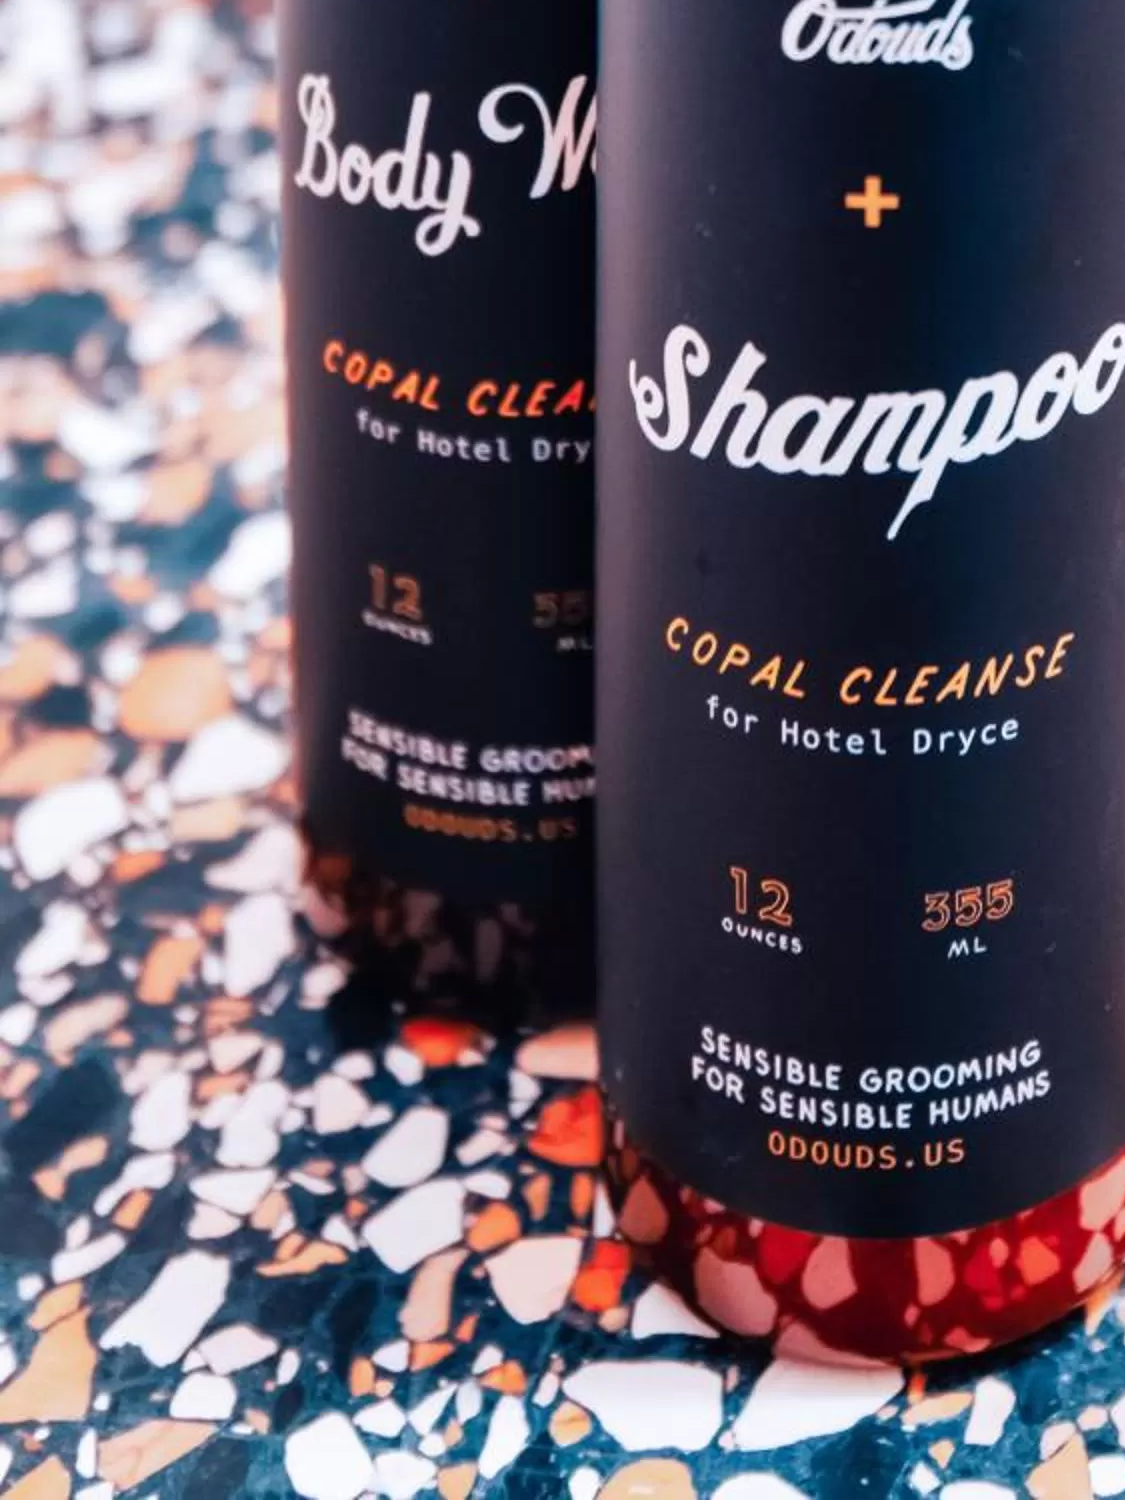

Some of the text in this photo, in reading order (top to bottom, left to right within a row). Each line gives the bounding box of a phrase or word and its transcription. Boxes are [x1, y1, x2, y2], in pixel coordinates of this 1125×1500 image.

[295, 74, 597, 257] Body W
[322, 340, 595, 418] COPAL CLEA
[357, 408, 401, 444] for
[417, 431, 511, 462] Hotel
[368, 563, 424, 622] 12
[665, 617, 1075, 706] COPAL CLEANSE
[348, 708, 468, 771] SENSIBLE
[706, 695, 1020, 756] for Hotel Dryce
[340, 736, 388, 782] FOR
[396, 761, 531, 807] SENSIBLE
[729, 866, 793, 928] 12
[922, 878, 1014, 931] 355
[721, 916, 803, 956] OUNCES
[947, 937, 988, 959] ML
[700, 1026, 1042, 1095] SENSIBLE GROOMING
[691, 1056, 1051, 1131] FOR SENSIBLE HUMANS
[767, 1130, 966, 1170] ODOUDS.US
